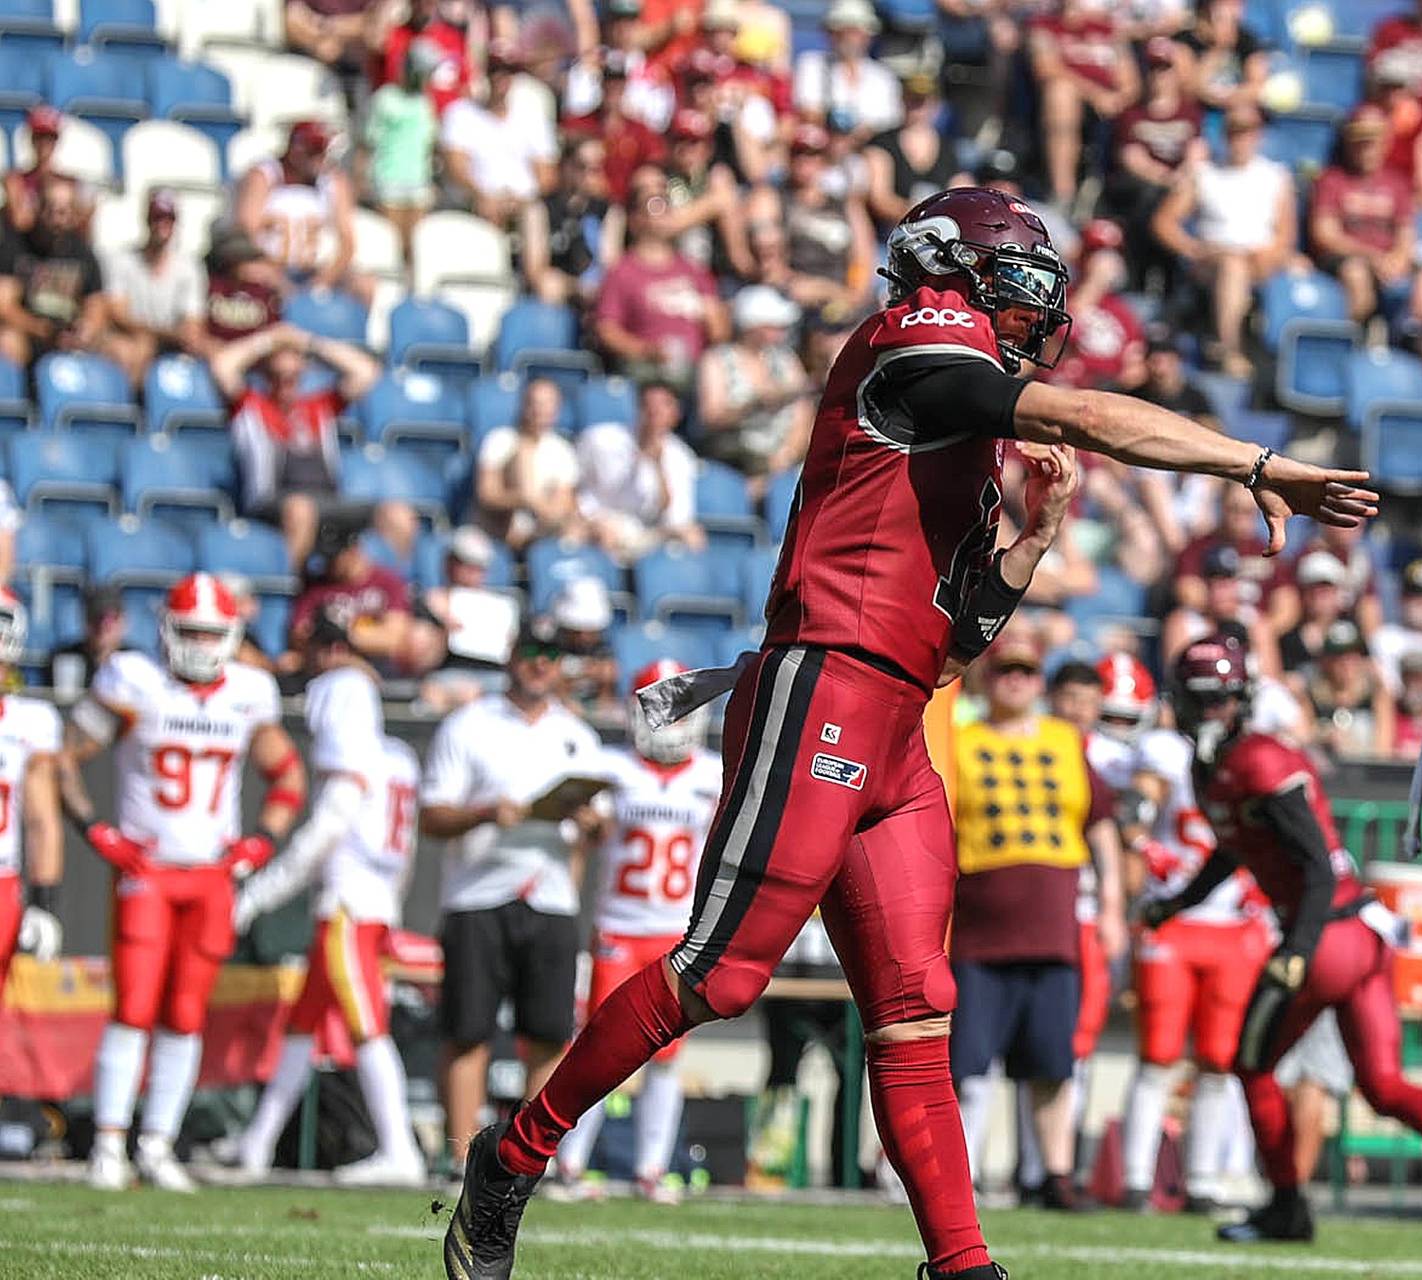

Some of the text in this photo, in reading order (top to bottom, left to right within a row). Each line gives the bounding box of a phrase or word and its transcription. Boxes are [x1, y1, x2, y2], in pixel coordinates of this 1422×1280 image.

[901, 307, 975, 328] pape
[153, 745, 236, 817] 97
[618, 829, 693, 901] 28
